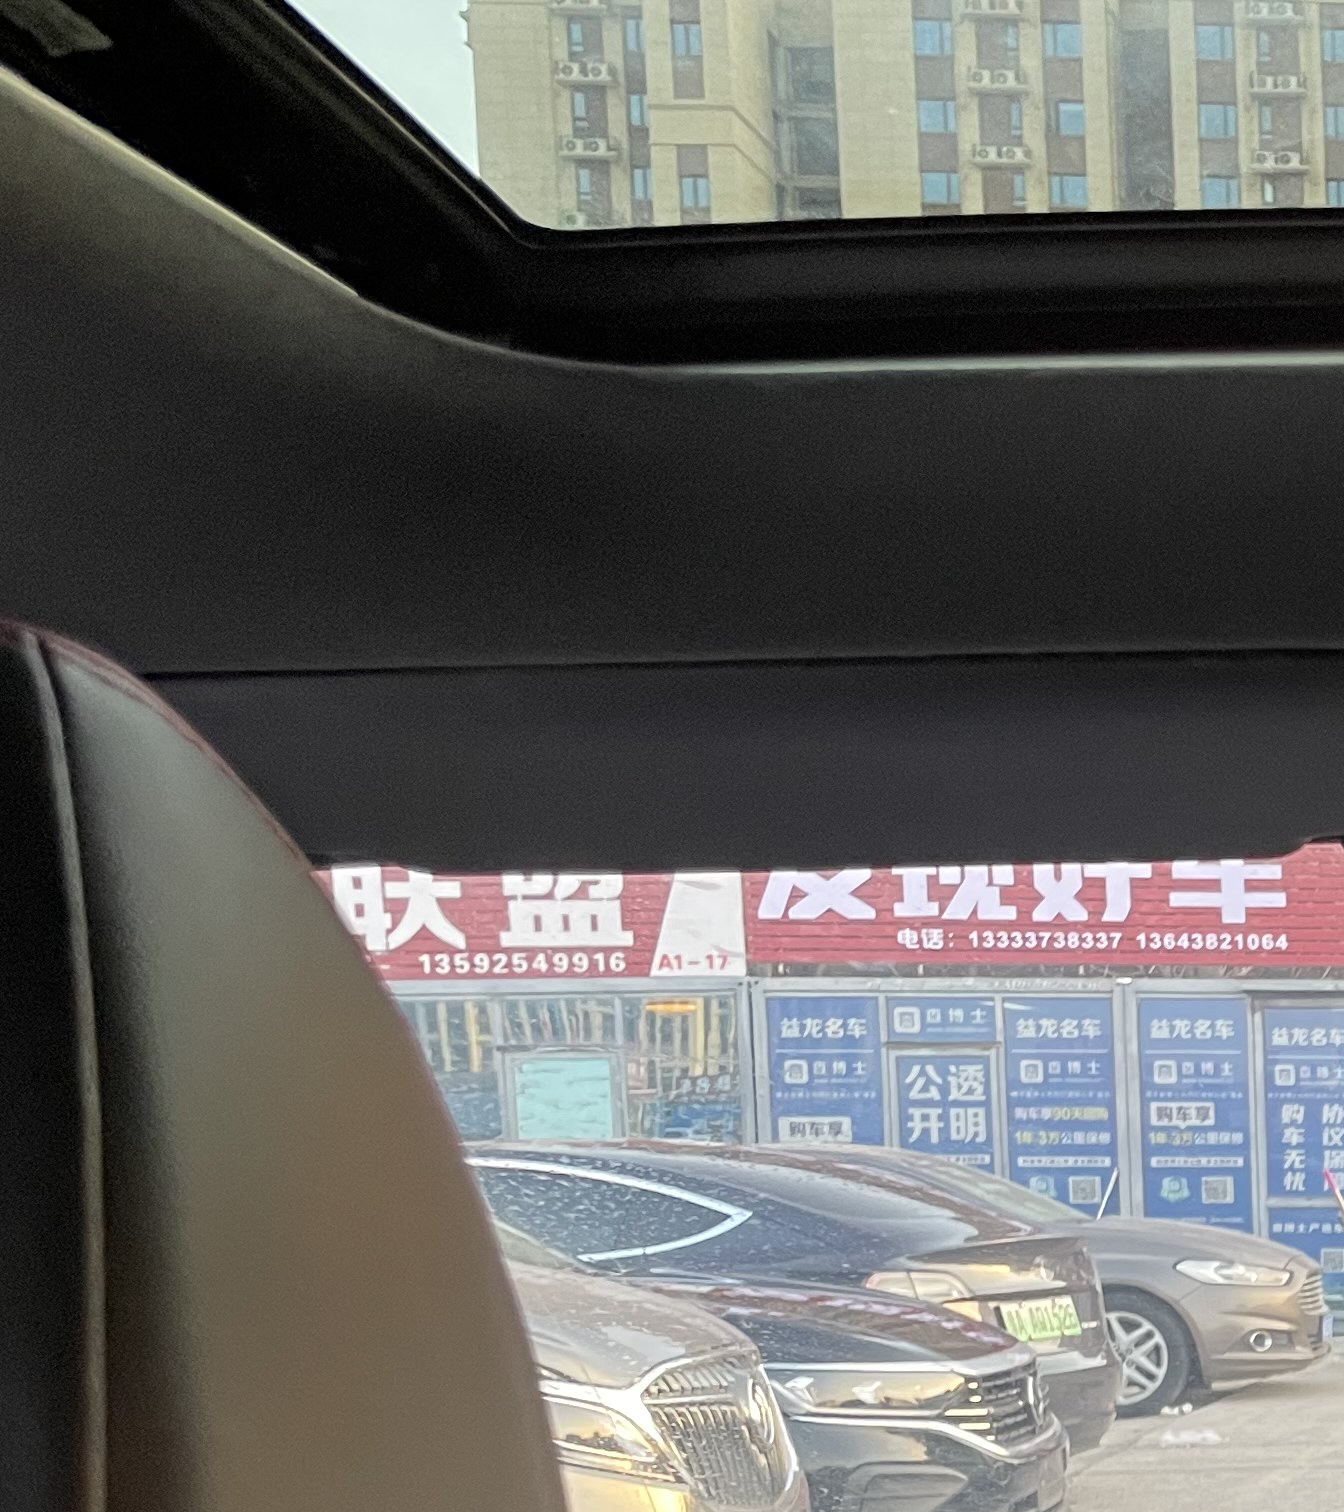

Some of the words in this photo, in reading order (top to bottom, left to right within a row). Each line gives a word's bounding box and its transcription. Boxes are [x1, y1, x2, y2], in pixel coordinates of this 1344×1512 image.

[968, 931, 1122, 948] 13333738337
[1136, 933, 1289, 950] 13643821064
[418, 951, 627, 974] 13592549916
[658, 954, 729, 971] A1-17
